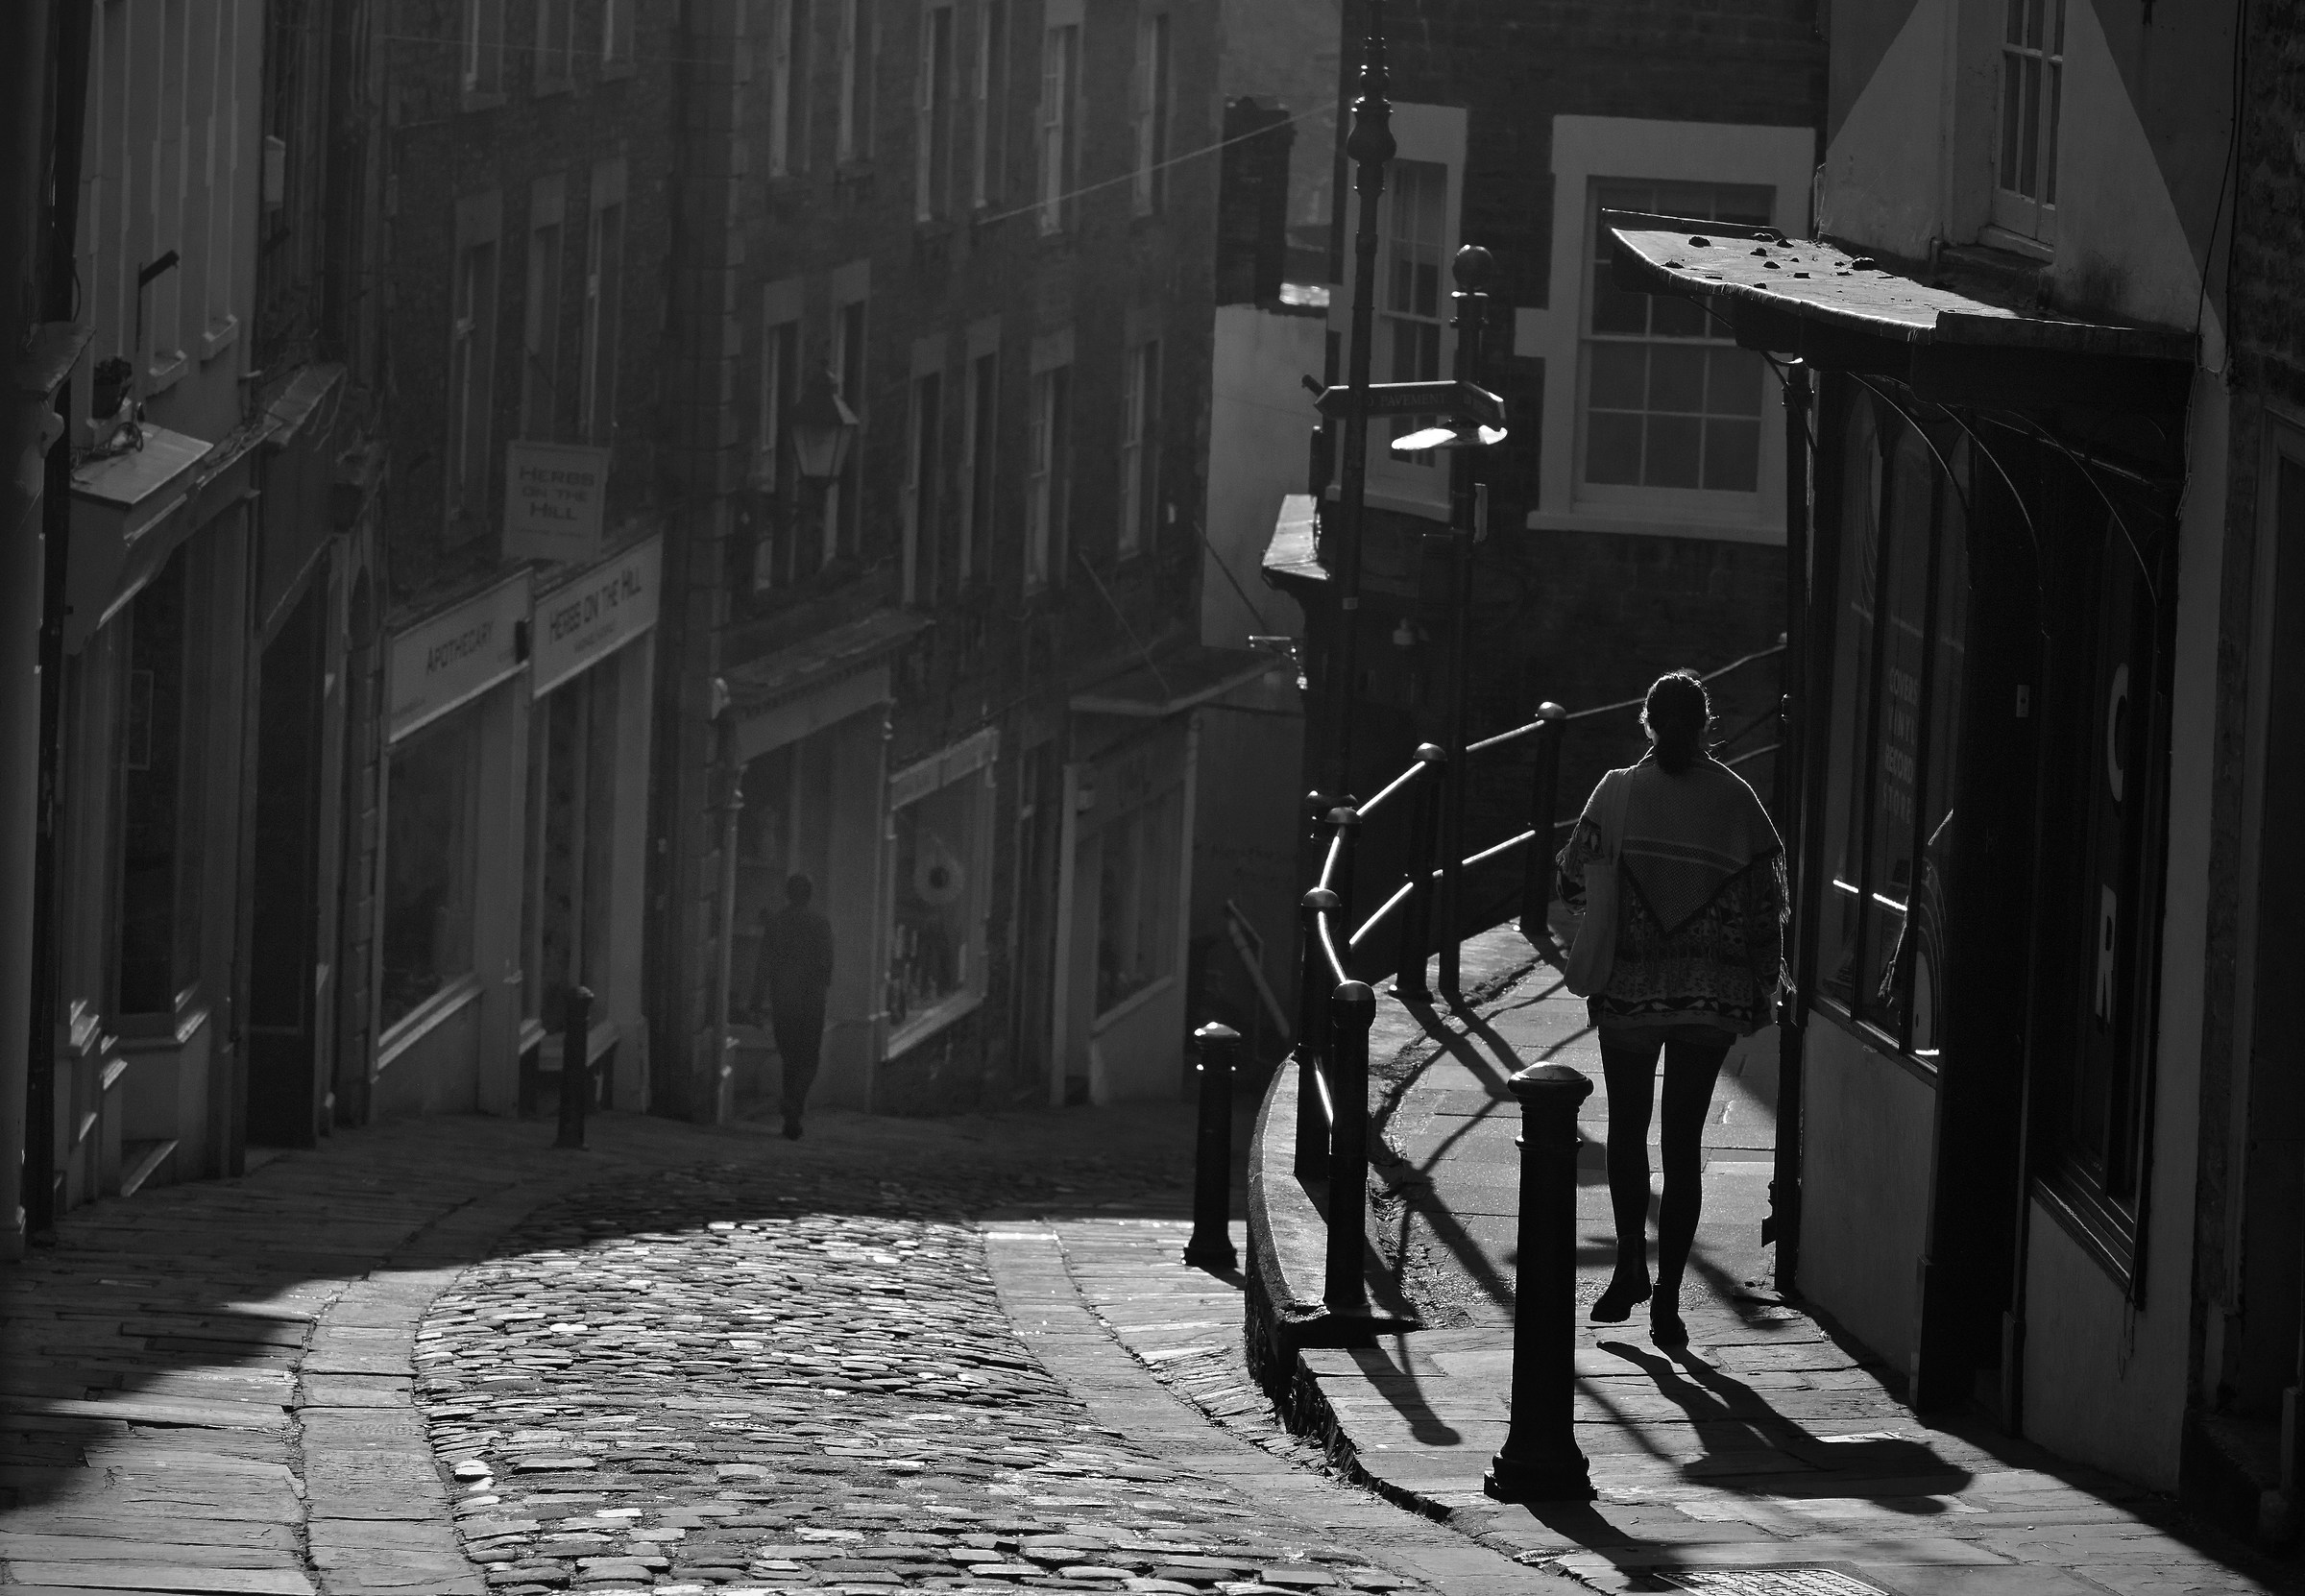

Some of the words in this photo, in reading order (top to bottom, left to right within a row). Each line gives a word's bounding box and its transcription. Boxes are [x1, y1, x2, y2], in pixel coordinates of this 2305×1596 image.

[1380, 393, 1447, 407] PAVEMENT
[519, 465, 594, 487] HERBS
[522, 485, 547, 497] ON
[555, 489, 588, 502] THE
[529, 501, 578, 520] HILL
[548, 601, 581, 644] HERBS
[584, 591, 599, 623] ON
[601, 578, 619, 612] THE
[621, 566, 642, 600] HILL
[425, 620, 495, 676] APOTHECARY
[1889, 666, 1919, 706] COVERS
[1887, 704, 1916, 745] VINYL
[1884, 742, 1914, 785] RECORD
[1882, 783, 1912, 824] STORE
